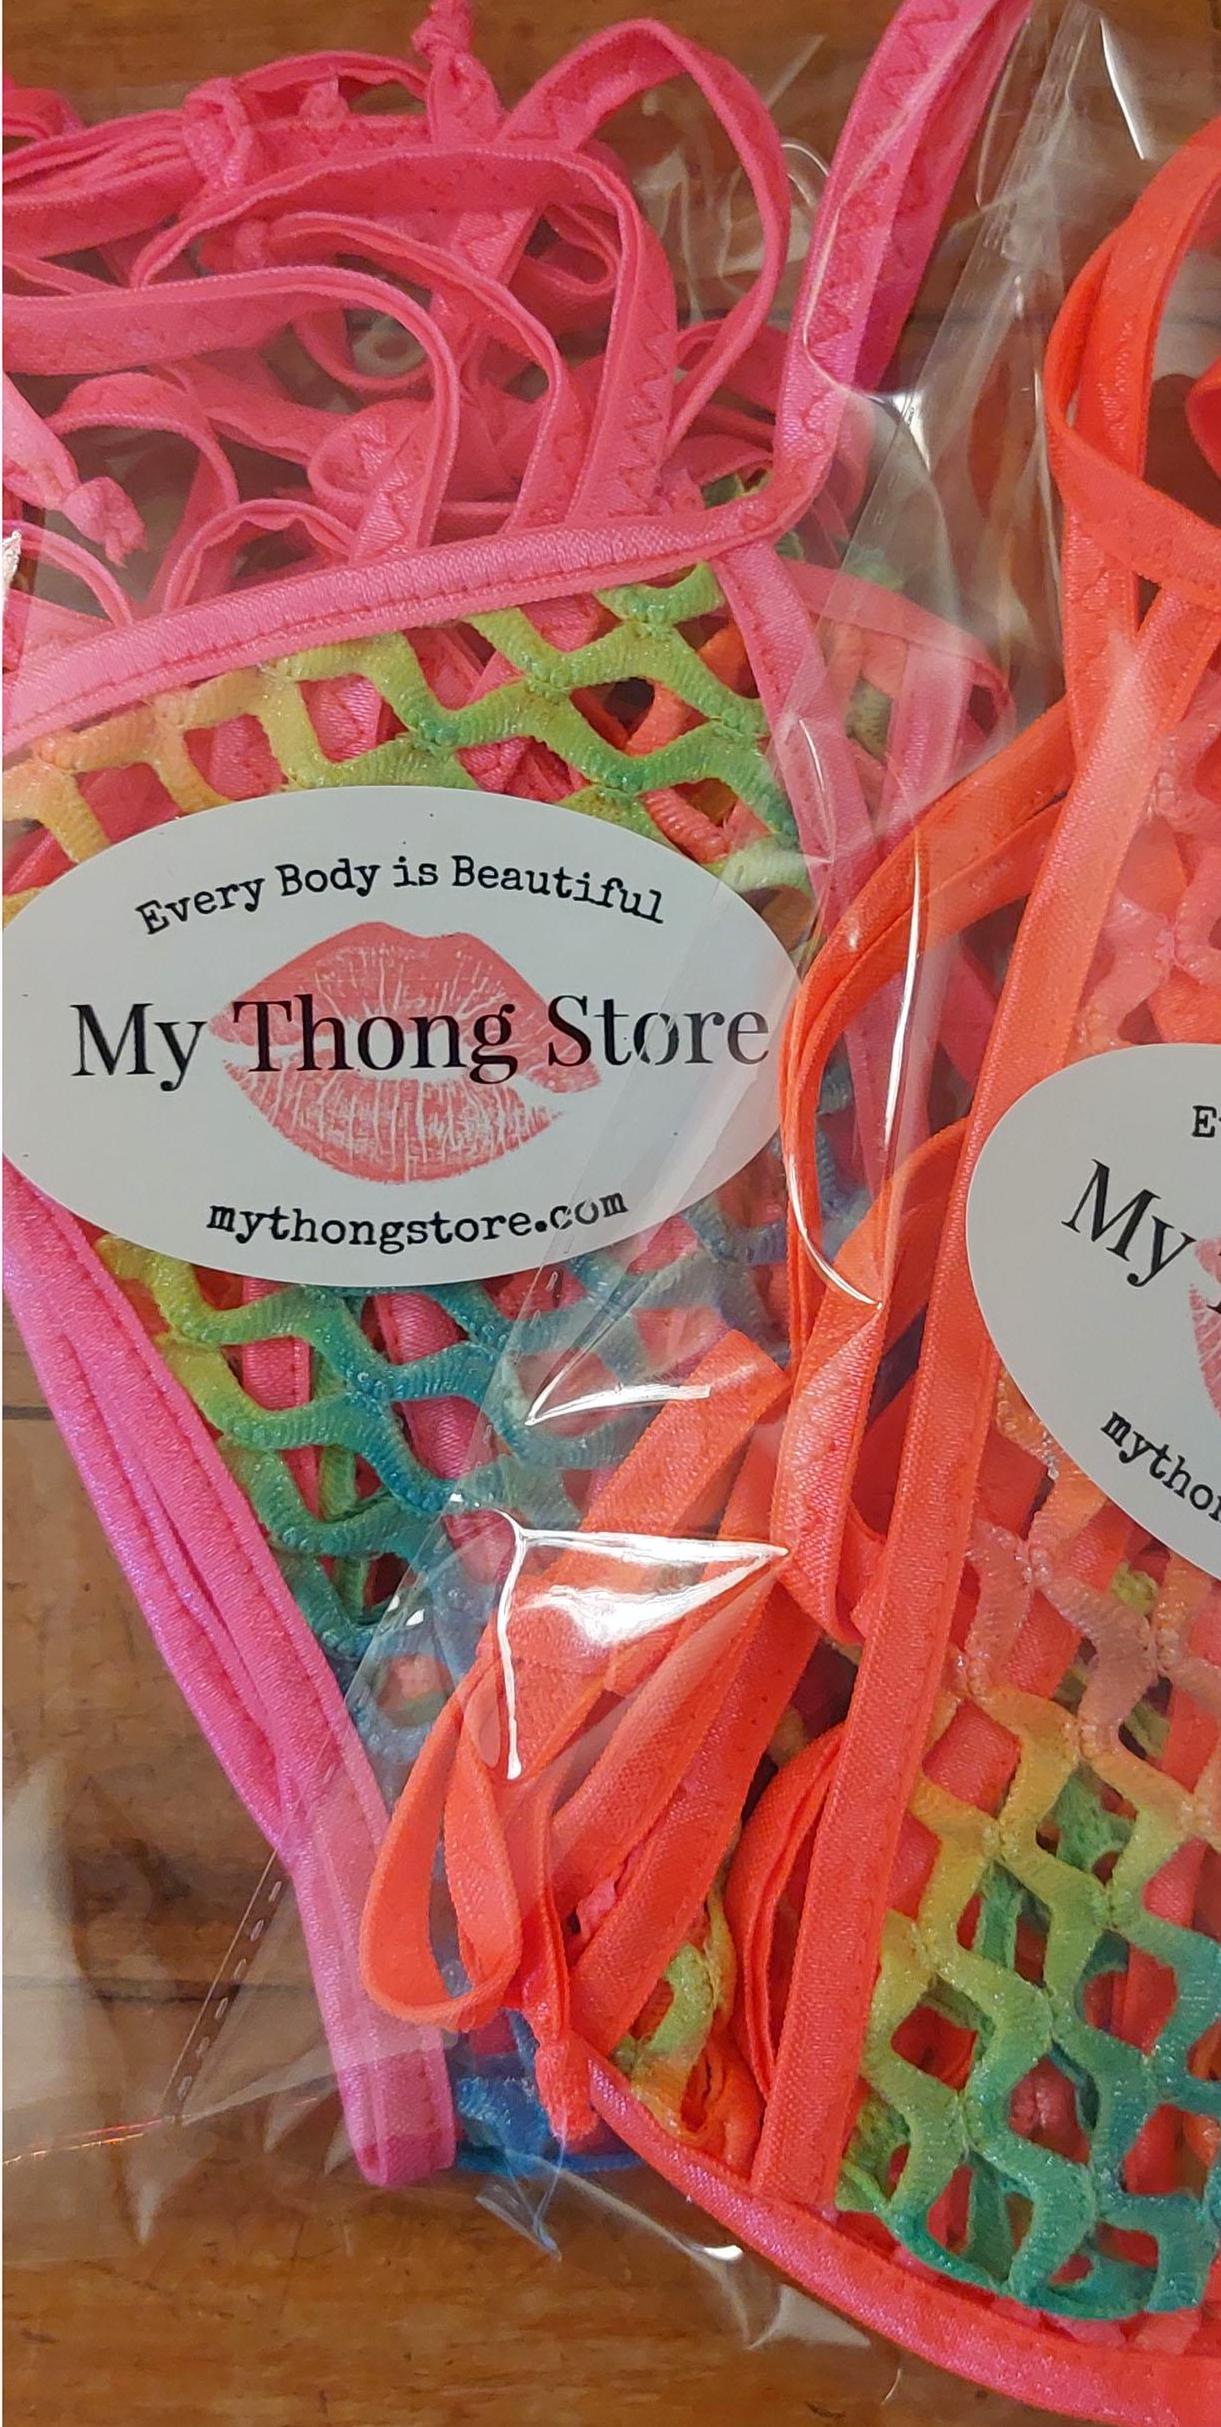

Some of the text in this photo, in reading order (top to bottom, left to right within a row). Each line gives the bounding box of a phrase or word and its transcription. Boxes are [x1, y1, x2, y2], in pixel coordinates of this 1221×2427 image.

[135, 855, 664, 935] Every Body is Beautiful
[70, 993, 769, 1092] My Thong Store
[1191, 1104, 1221, 1139] E
[207, 1192, 629, 1255] mythongstore.com
[1061, 1158, 1197, 1288] My
